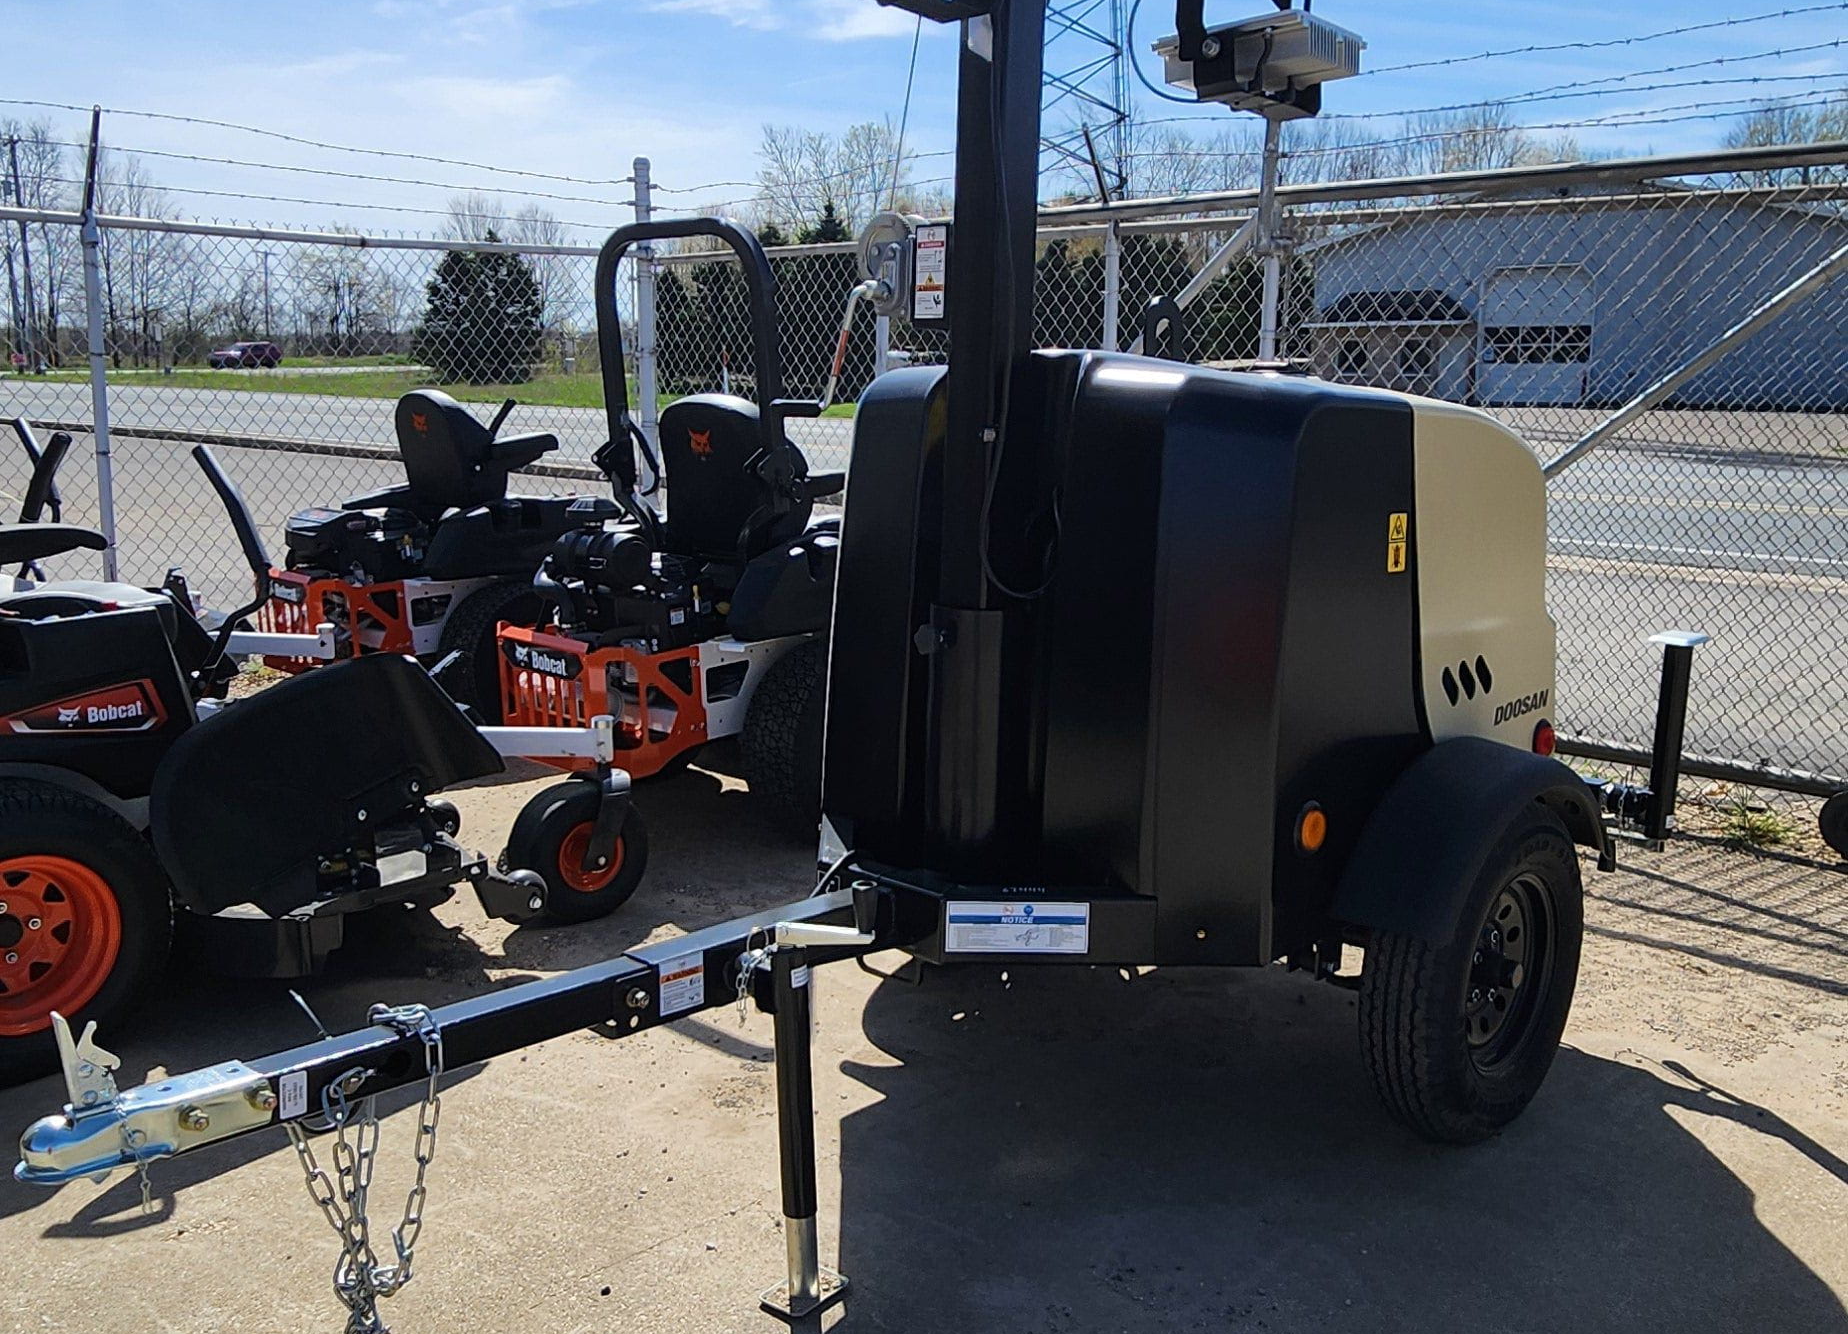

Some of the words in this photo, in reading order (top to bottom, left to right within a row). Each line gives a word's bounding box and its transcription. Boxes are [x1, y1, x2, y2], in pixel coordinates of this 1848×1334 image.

[531, 650, 568, 677] Bobcat
[87, 700, 143, 724] Bobcat
[1493, 688, 1549, 727] DOOSAN
[1001, 916, 1034, 924] NOTICE
